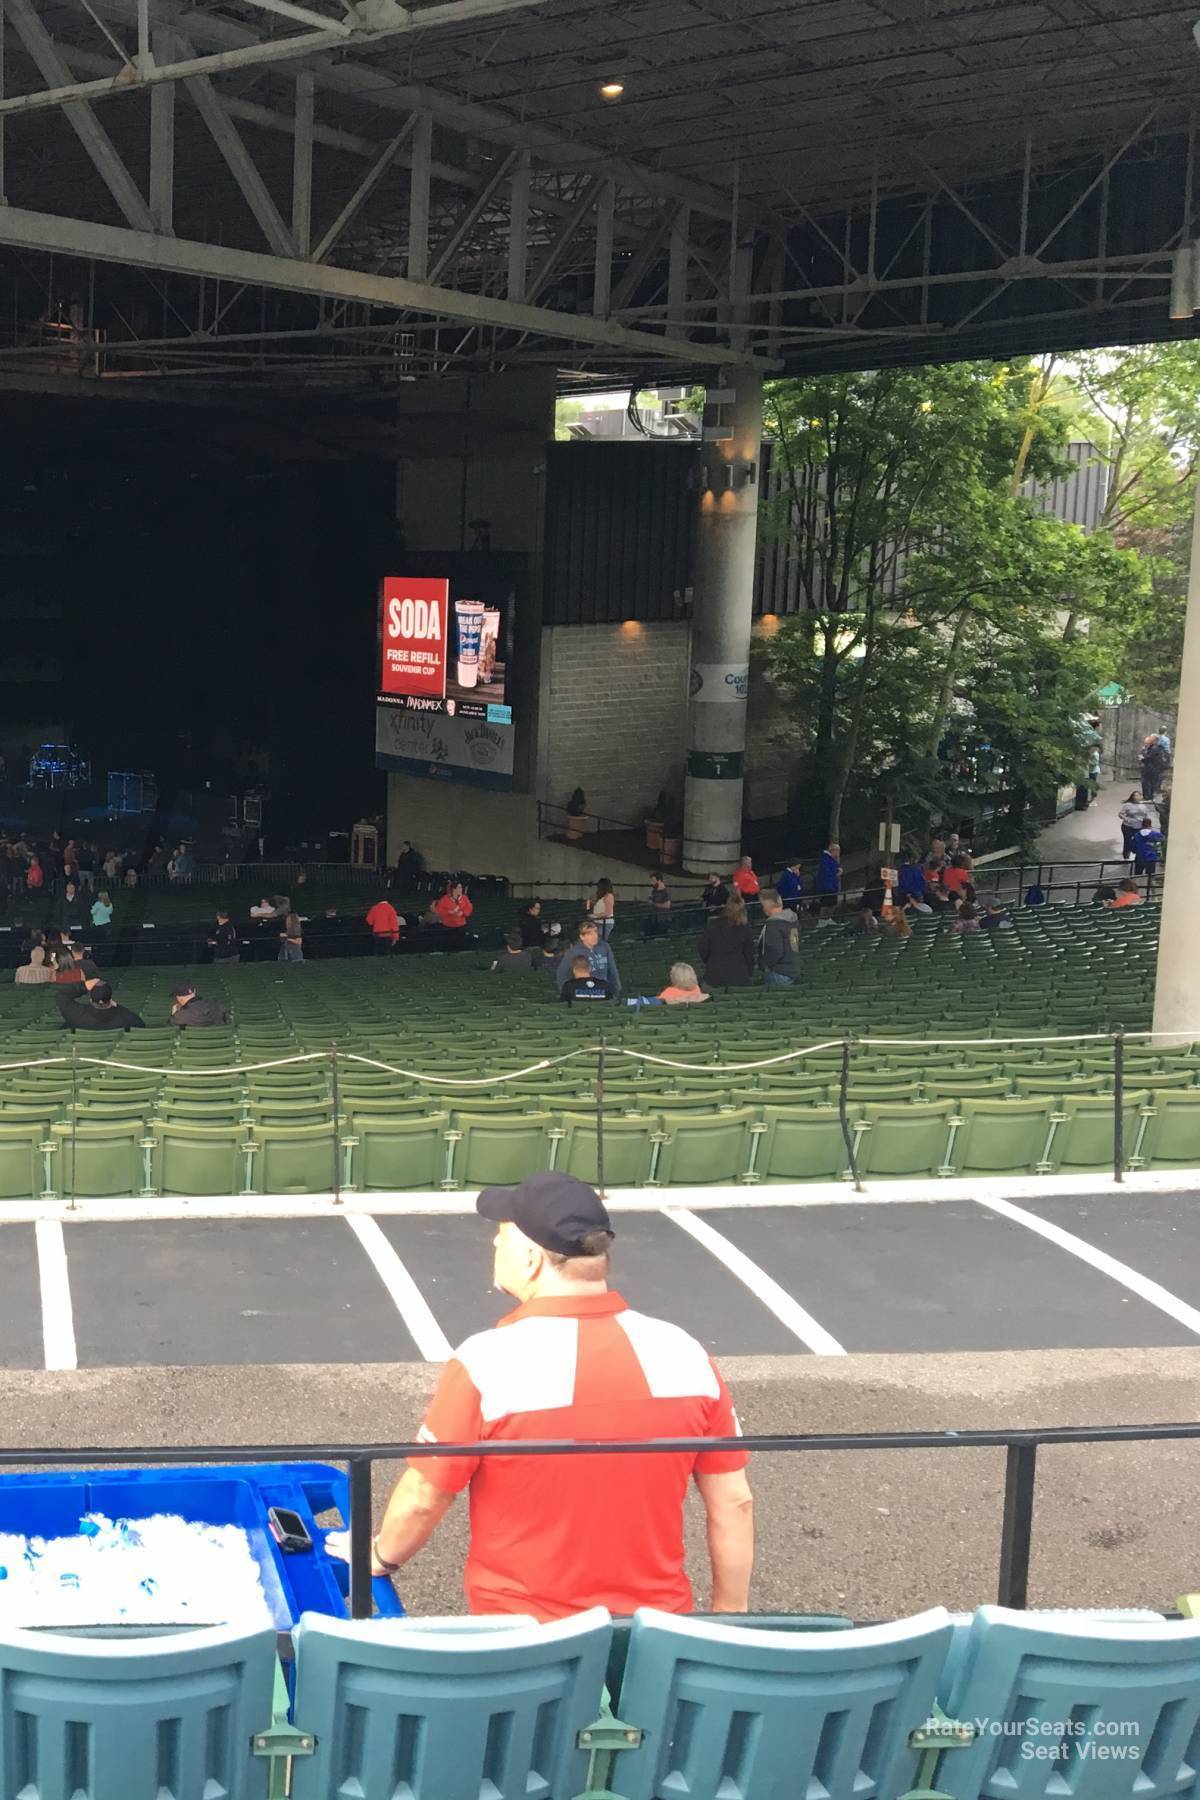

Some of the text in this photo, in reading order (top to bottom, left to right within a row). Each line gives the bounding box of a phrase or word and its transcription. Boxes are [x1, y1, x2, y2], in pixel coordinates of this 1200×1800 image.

[388, 597, 441, 640] SODA
[386, 648, 441, 665] FREE REFILL
[391, 663, 436, 676] SOUVENIR CUP
[376, 695, 404, 705] MADONNA
[389, 708, 435, 738] xfinity
[393, 736, 429, 755] center
